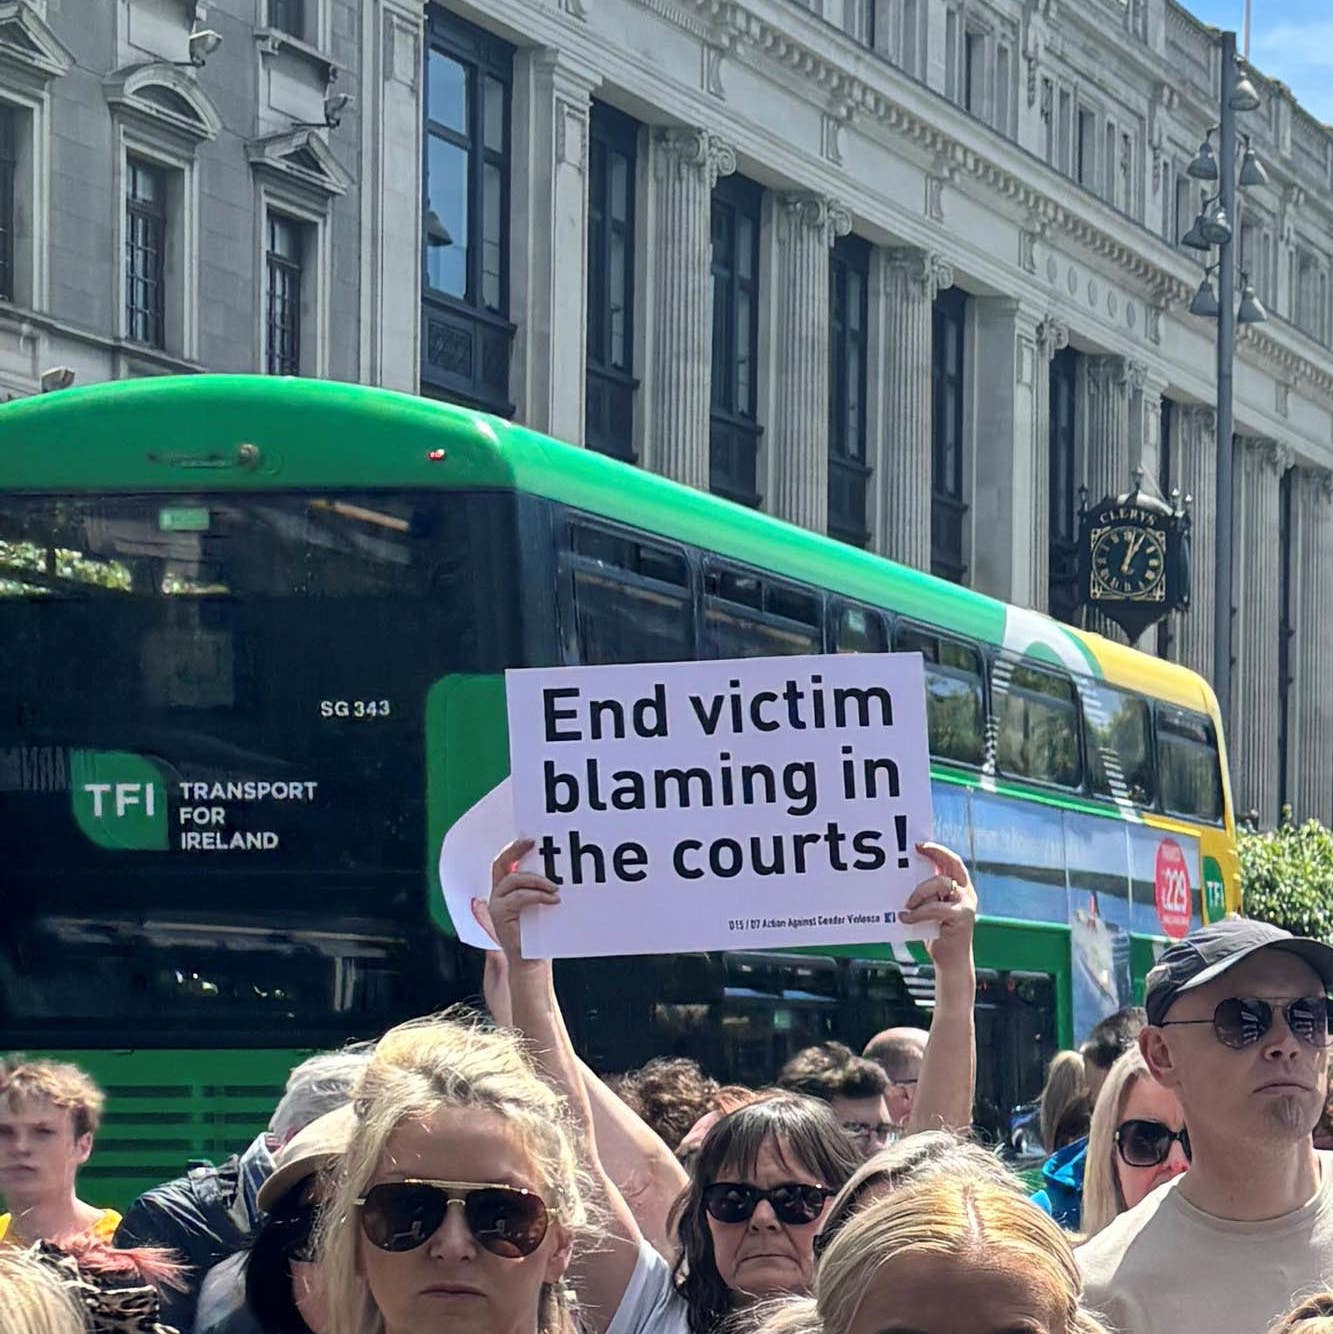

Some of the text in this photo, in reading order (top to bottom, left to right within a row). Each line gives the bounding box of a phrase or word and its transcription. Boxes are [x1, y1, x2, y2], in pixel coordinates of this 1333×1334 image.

[1100, 508, 1157, 526] CLERYS
[321, 700, 390, 717] SG 343
[543, 675, 894, 742] End victim
[179, 781, 318, 800] TRANSPORT
[544, 746, 900, 816] blaming in
[85, 783, 154, 817] TFI
[180, 807, 225, 824] FOR
[181, 831, 279, 850] IRELAND
[539, 831, 648, 886] the
[673, 815, 909, 880] courts!
